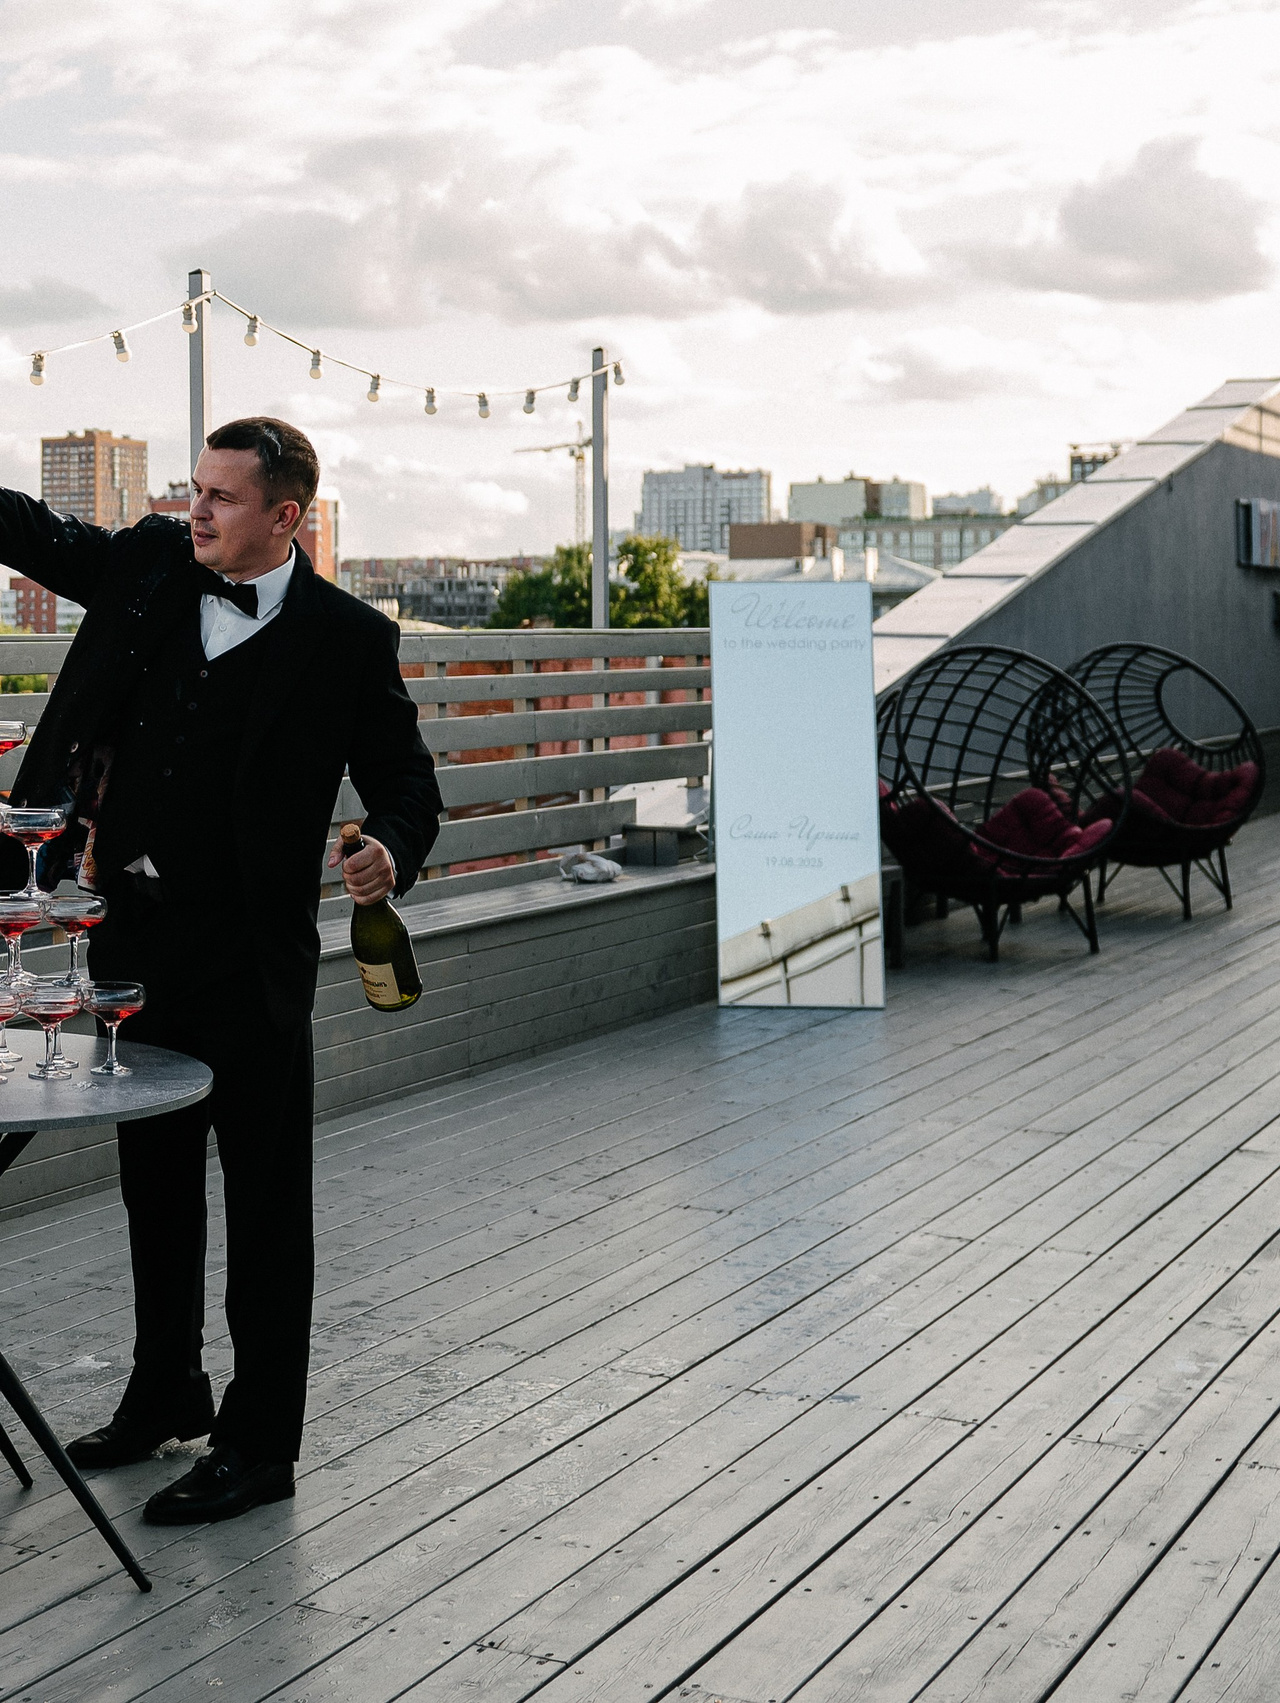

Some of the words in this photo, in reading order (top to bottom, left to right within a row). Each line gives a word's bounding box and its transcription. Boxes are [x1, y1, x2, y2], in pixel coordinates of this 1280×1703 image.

[731, 592, 855, 629] Welcome
[724, 638, 738, 648] to
[741, 637, 763, 648] the
[767, 637, 826, 652] wedding
[830, 638, 866, 652] party
